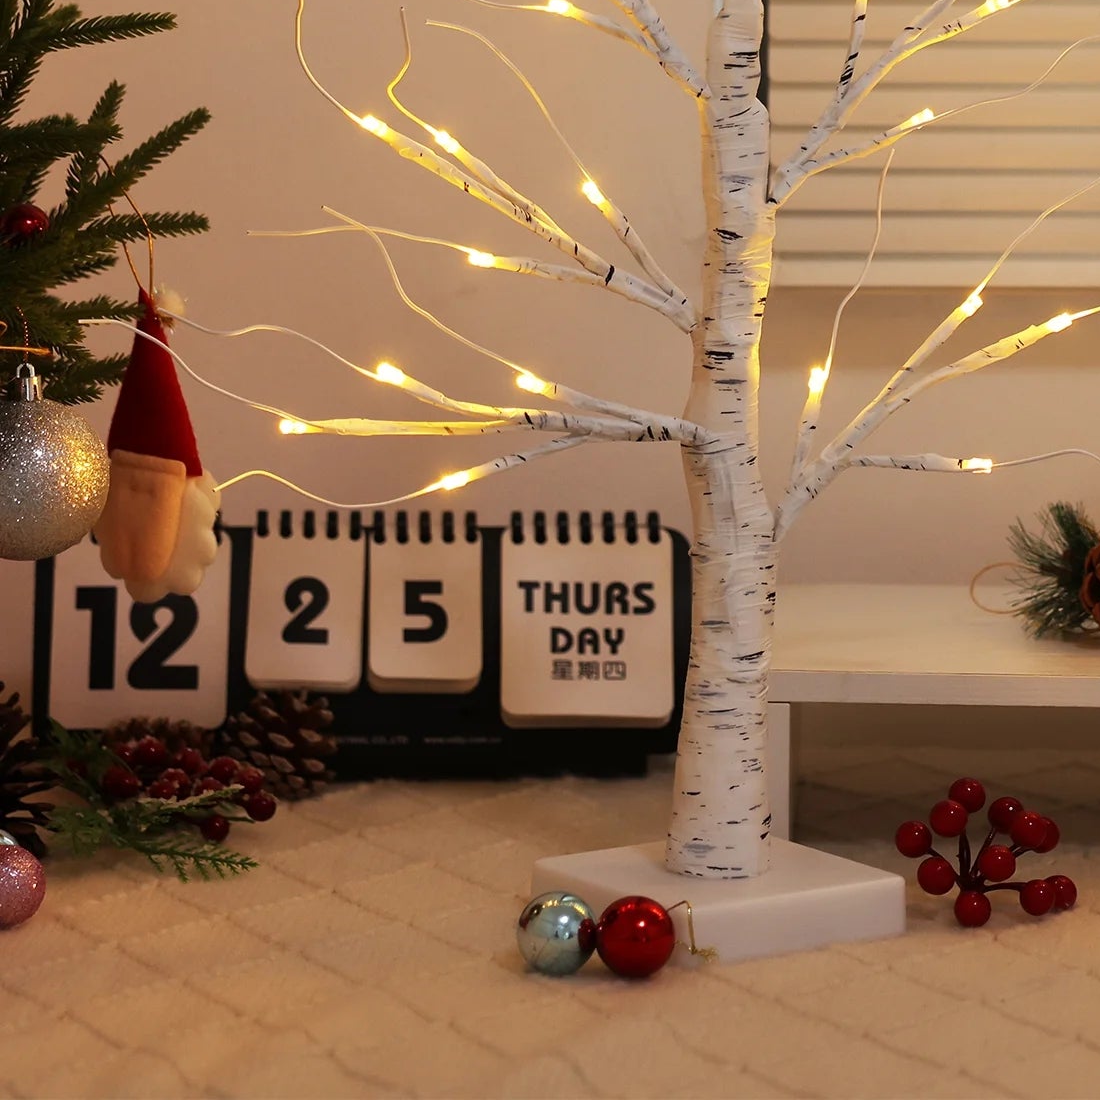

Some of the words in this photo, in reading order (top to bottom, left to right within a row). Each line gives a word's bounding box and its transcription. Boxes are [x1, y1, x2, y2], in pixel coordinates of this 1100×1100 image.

[281, 575, 331, 646] 2
[402, 579, 449, 644] 5
[516, 579, 657, 616] THURS
[74, 585, 200, 693] 12
[549, 626, 625, 656] DAY
[550, 658, 627, 681] 星期四
